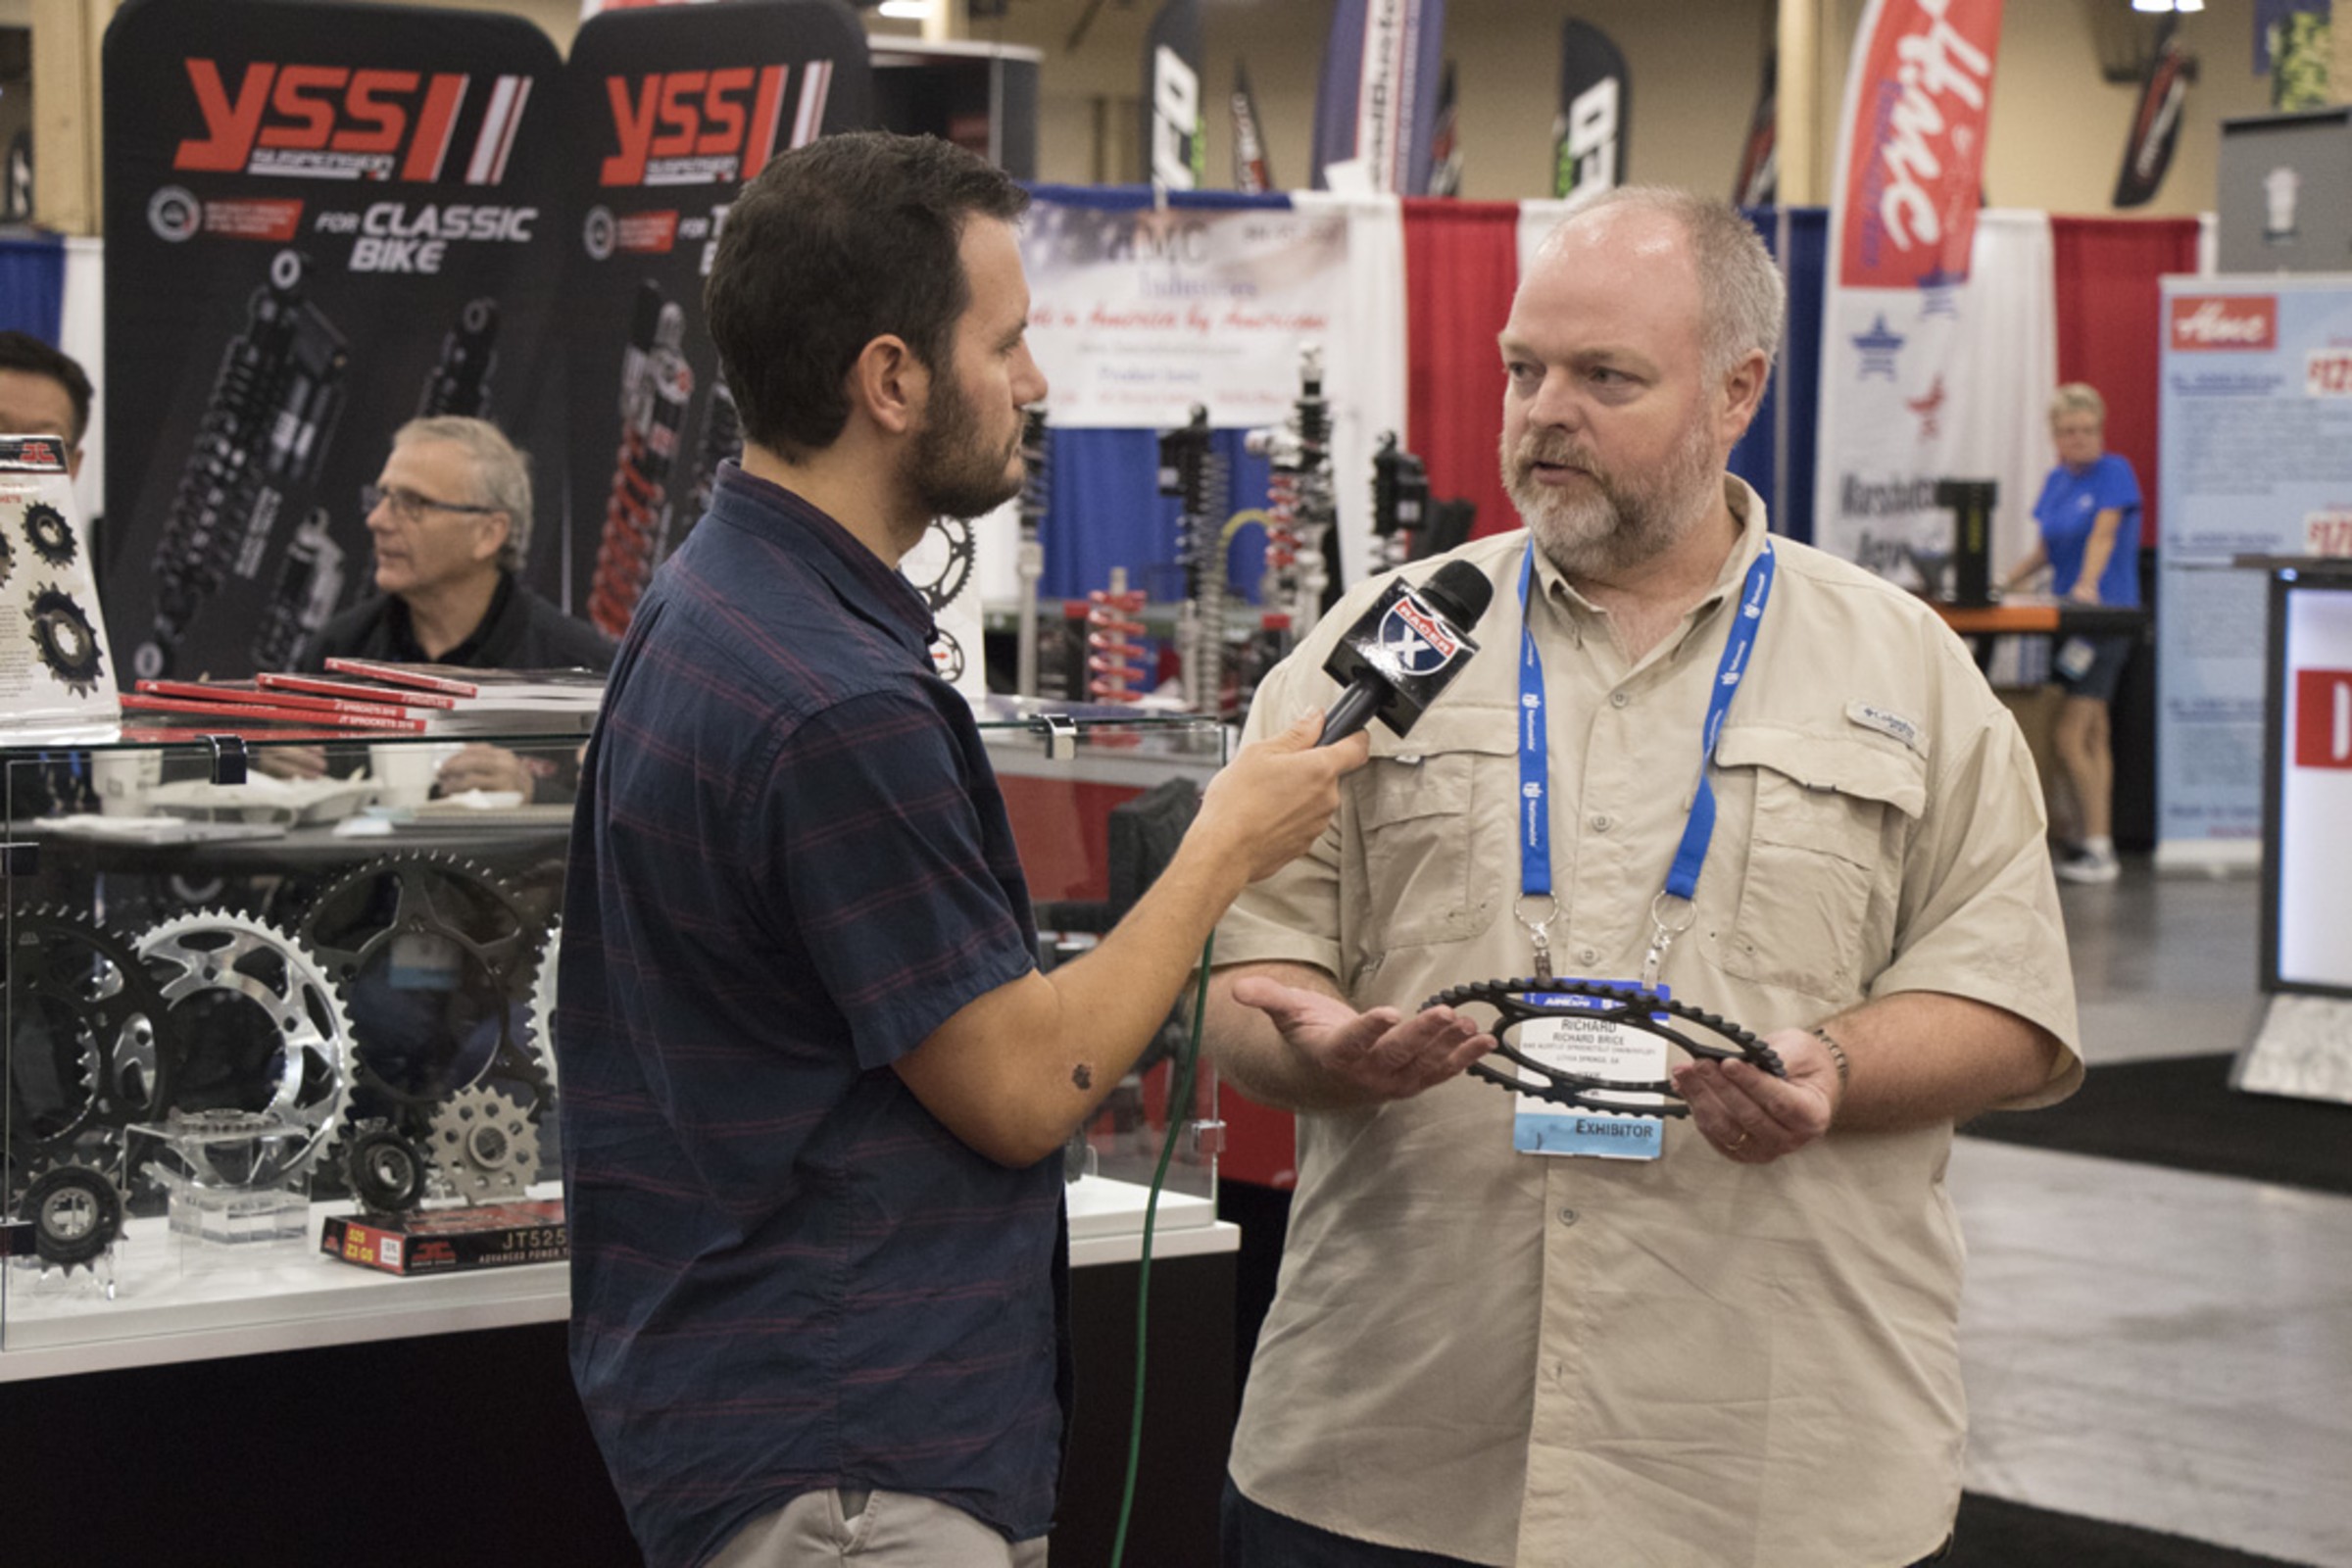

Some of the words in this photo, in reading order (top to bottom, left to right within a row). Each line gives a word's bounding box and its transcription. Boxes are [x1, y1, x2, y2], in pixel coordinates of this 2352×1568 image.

[315, 211, 360, 233] FOR
[362, 201, 538, 242] CLASSIC
[348, 238, 448, 274] BIKE
[1398, 605, 1451, 654] RACER
[1385, 623, 1432, 669] X
[1552, 1032, 1594, 1044] RICHARD
[1597, 1034, 1625, 1046] BRICE
[1561, 1018, 1617, 1033] RICHARD
[1576, 1118, 1654, 1138] EXHIBITOR
[528, 1249, 562, 1261] POWER
